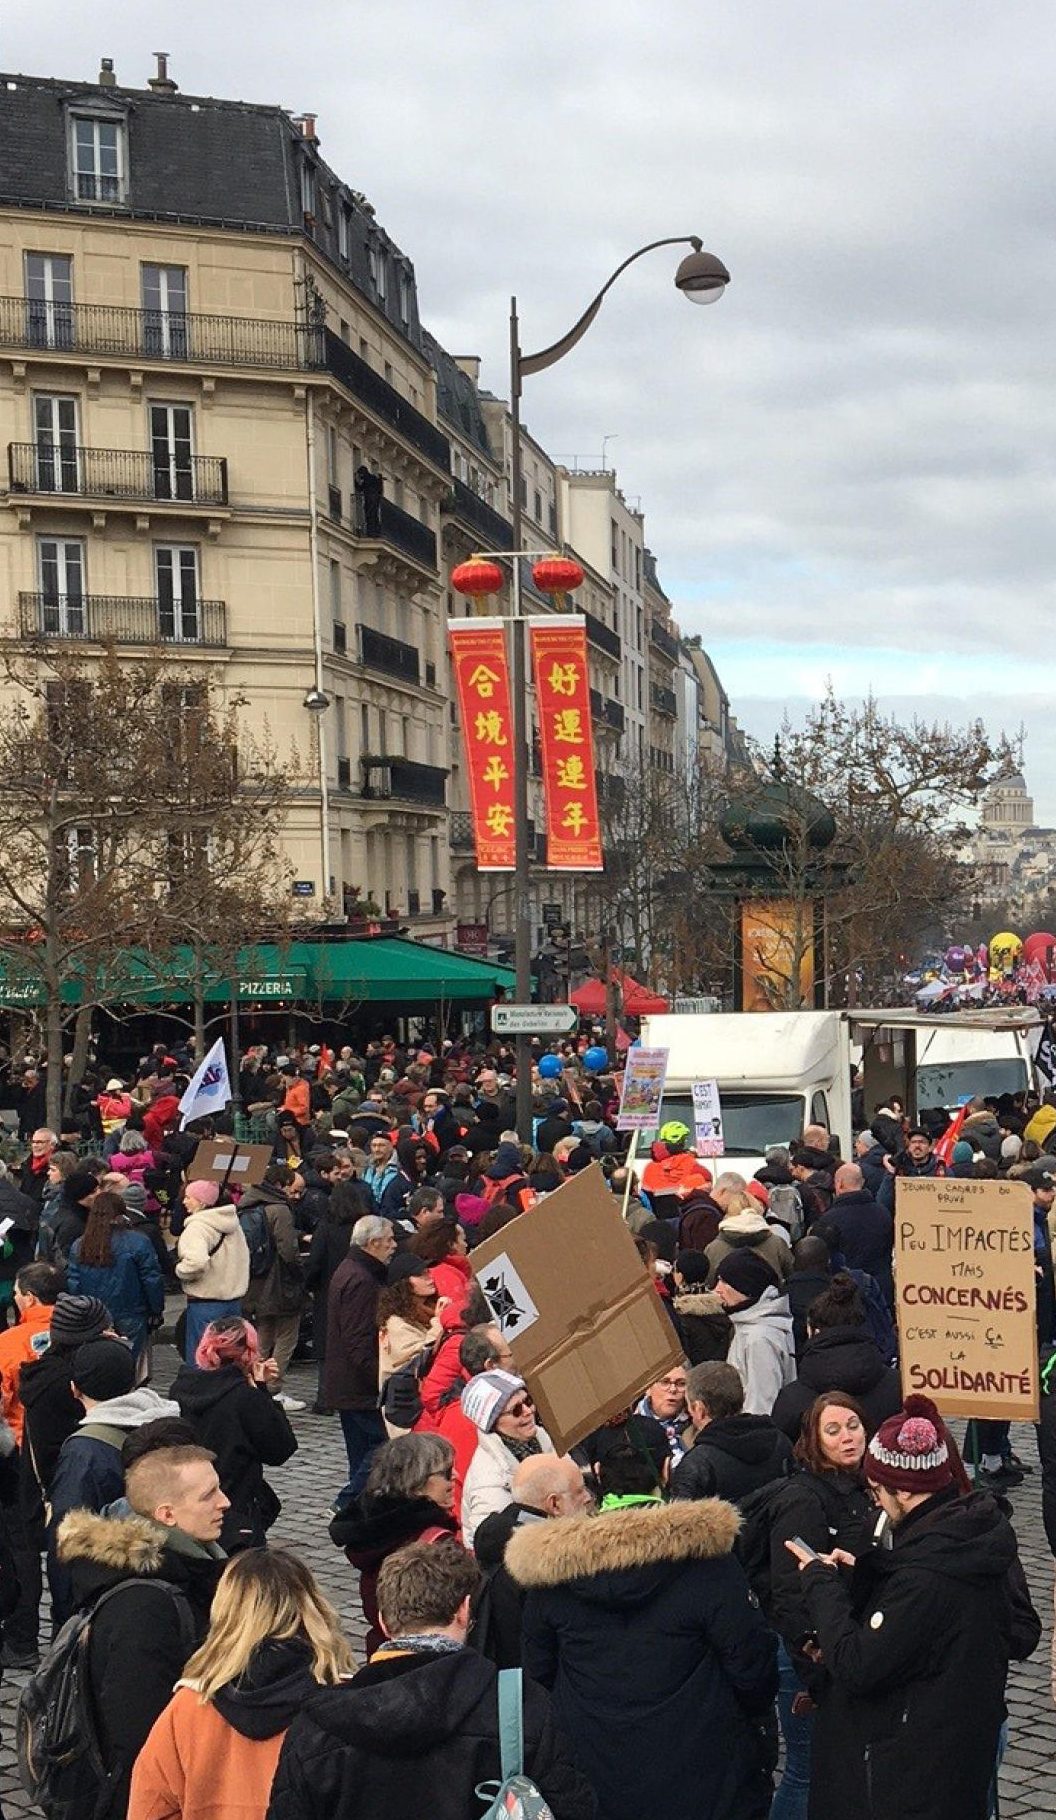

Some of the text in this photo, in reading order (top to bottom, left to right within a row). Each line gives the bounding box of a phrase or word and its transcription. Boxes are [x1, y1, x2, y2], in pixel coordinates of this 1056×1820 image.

[239, 982, 293, 995] PIZZERIA
[945, 1184, 985, 1194] CADRES
[930, 1224, 1032, 1253] IMPACTÉS
[950, 1262, 984, 1278] MAIS
[902, 1284, 1028, 1312] CONCERNÉS
[905, 1327, 937, 1340] C'EST
[949, 1351, 966, 1360] LA
[909, 1363, 1031, 1395] SOLIDARITÉ
